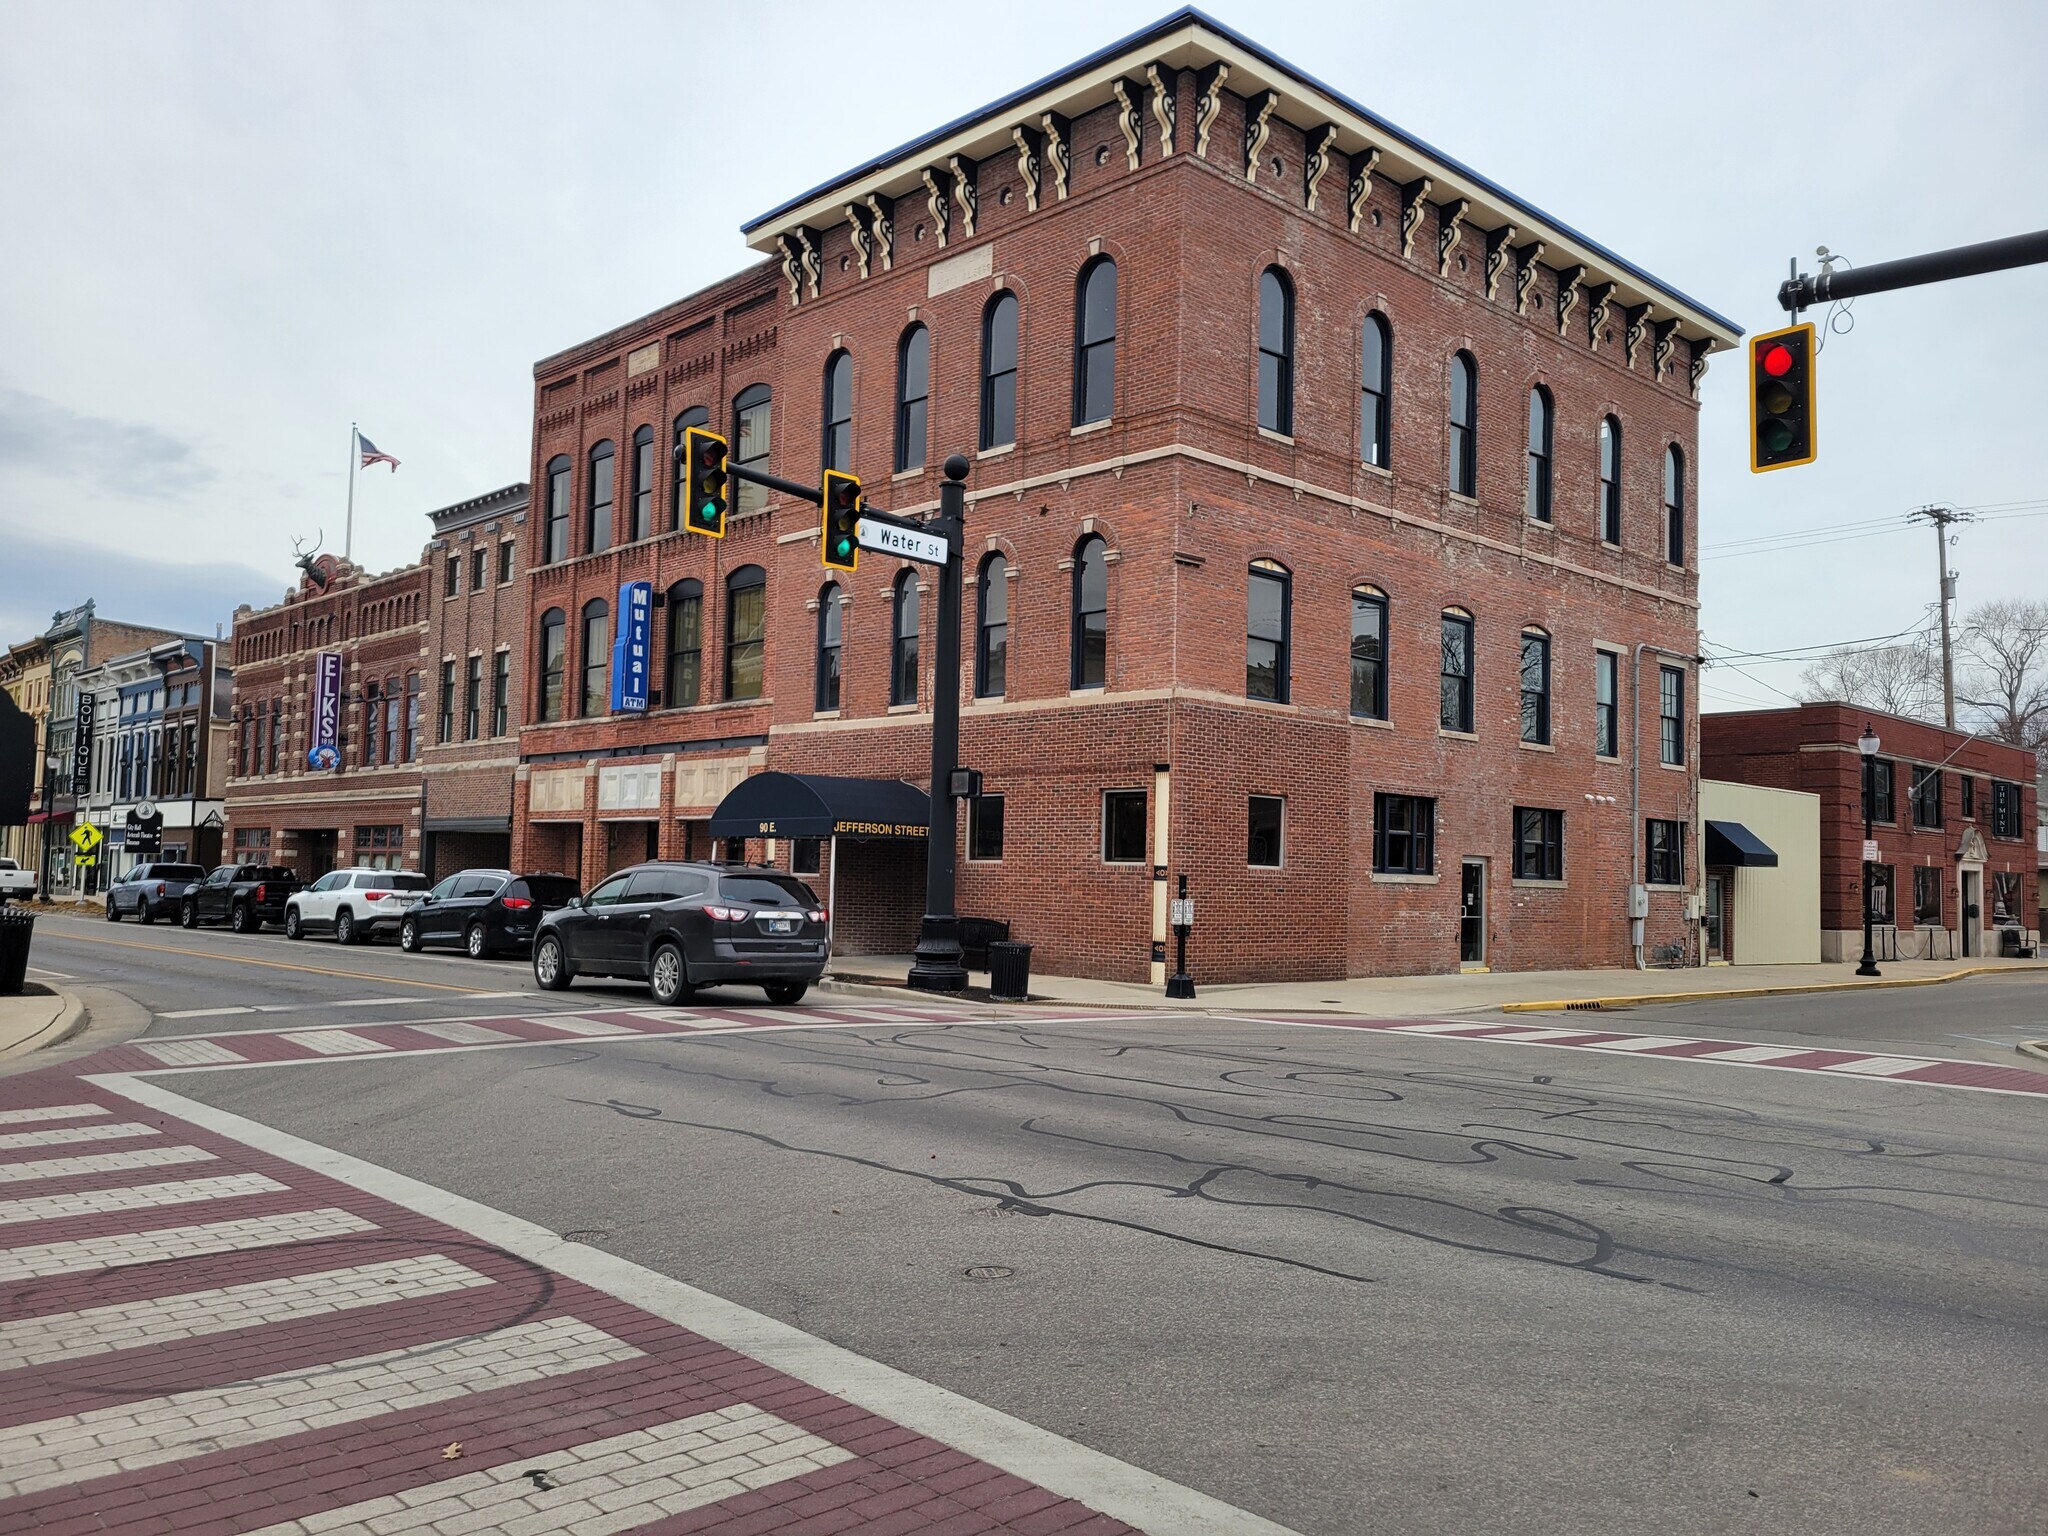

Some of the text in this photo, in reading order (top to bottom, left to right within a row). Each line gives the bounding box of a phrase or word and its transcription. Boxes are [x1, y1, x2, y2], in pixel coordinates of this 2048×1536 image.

[881, 529, 939, 556] Water St
[632, 588, 648, 693] Mutual
[321, 656, 338, 738] ELKS
[625, 697, 644, 708] ATM
[78, 694, 92, 776] BOUTIQUE
[759, 821, 777, 833] 90 E.
[833, 821, 930, 837] JEFFERSON STREET
